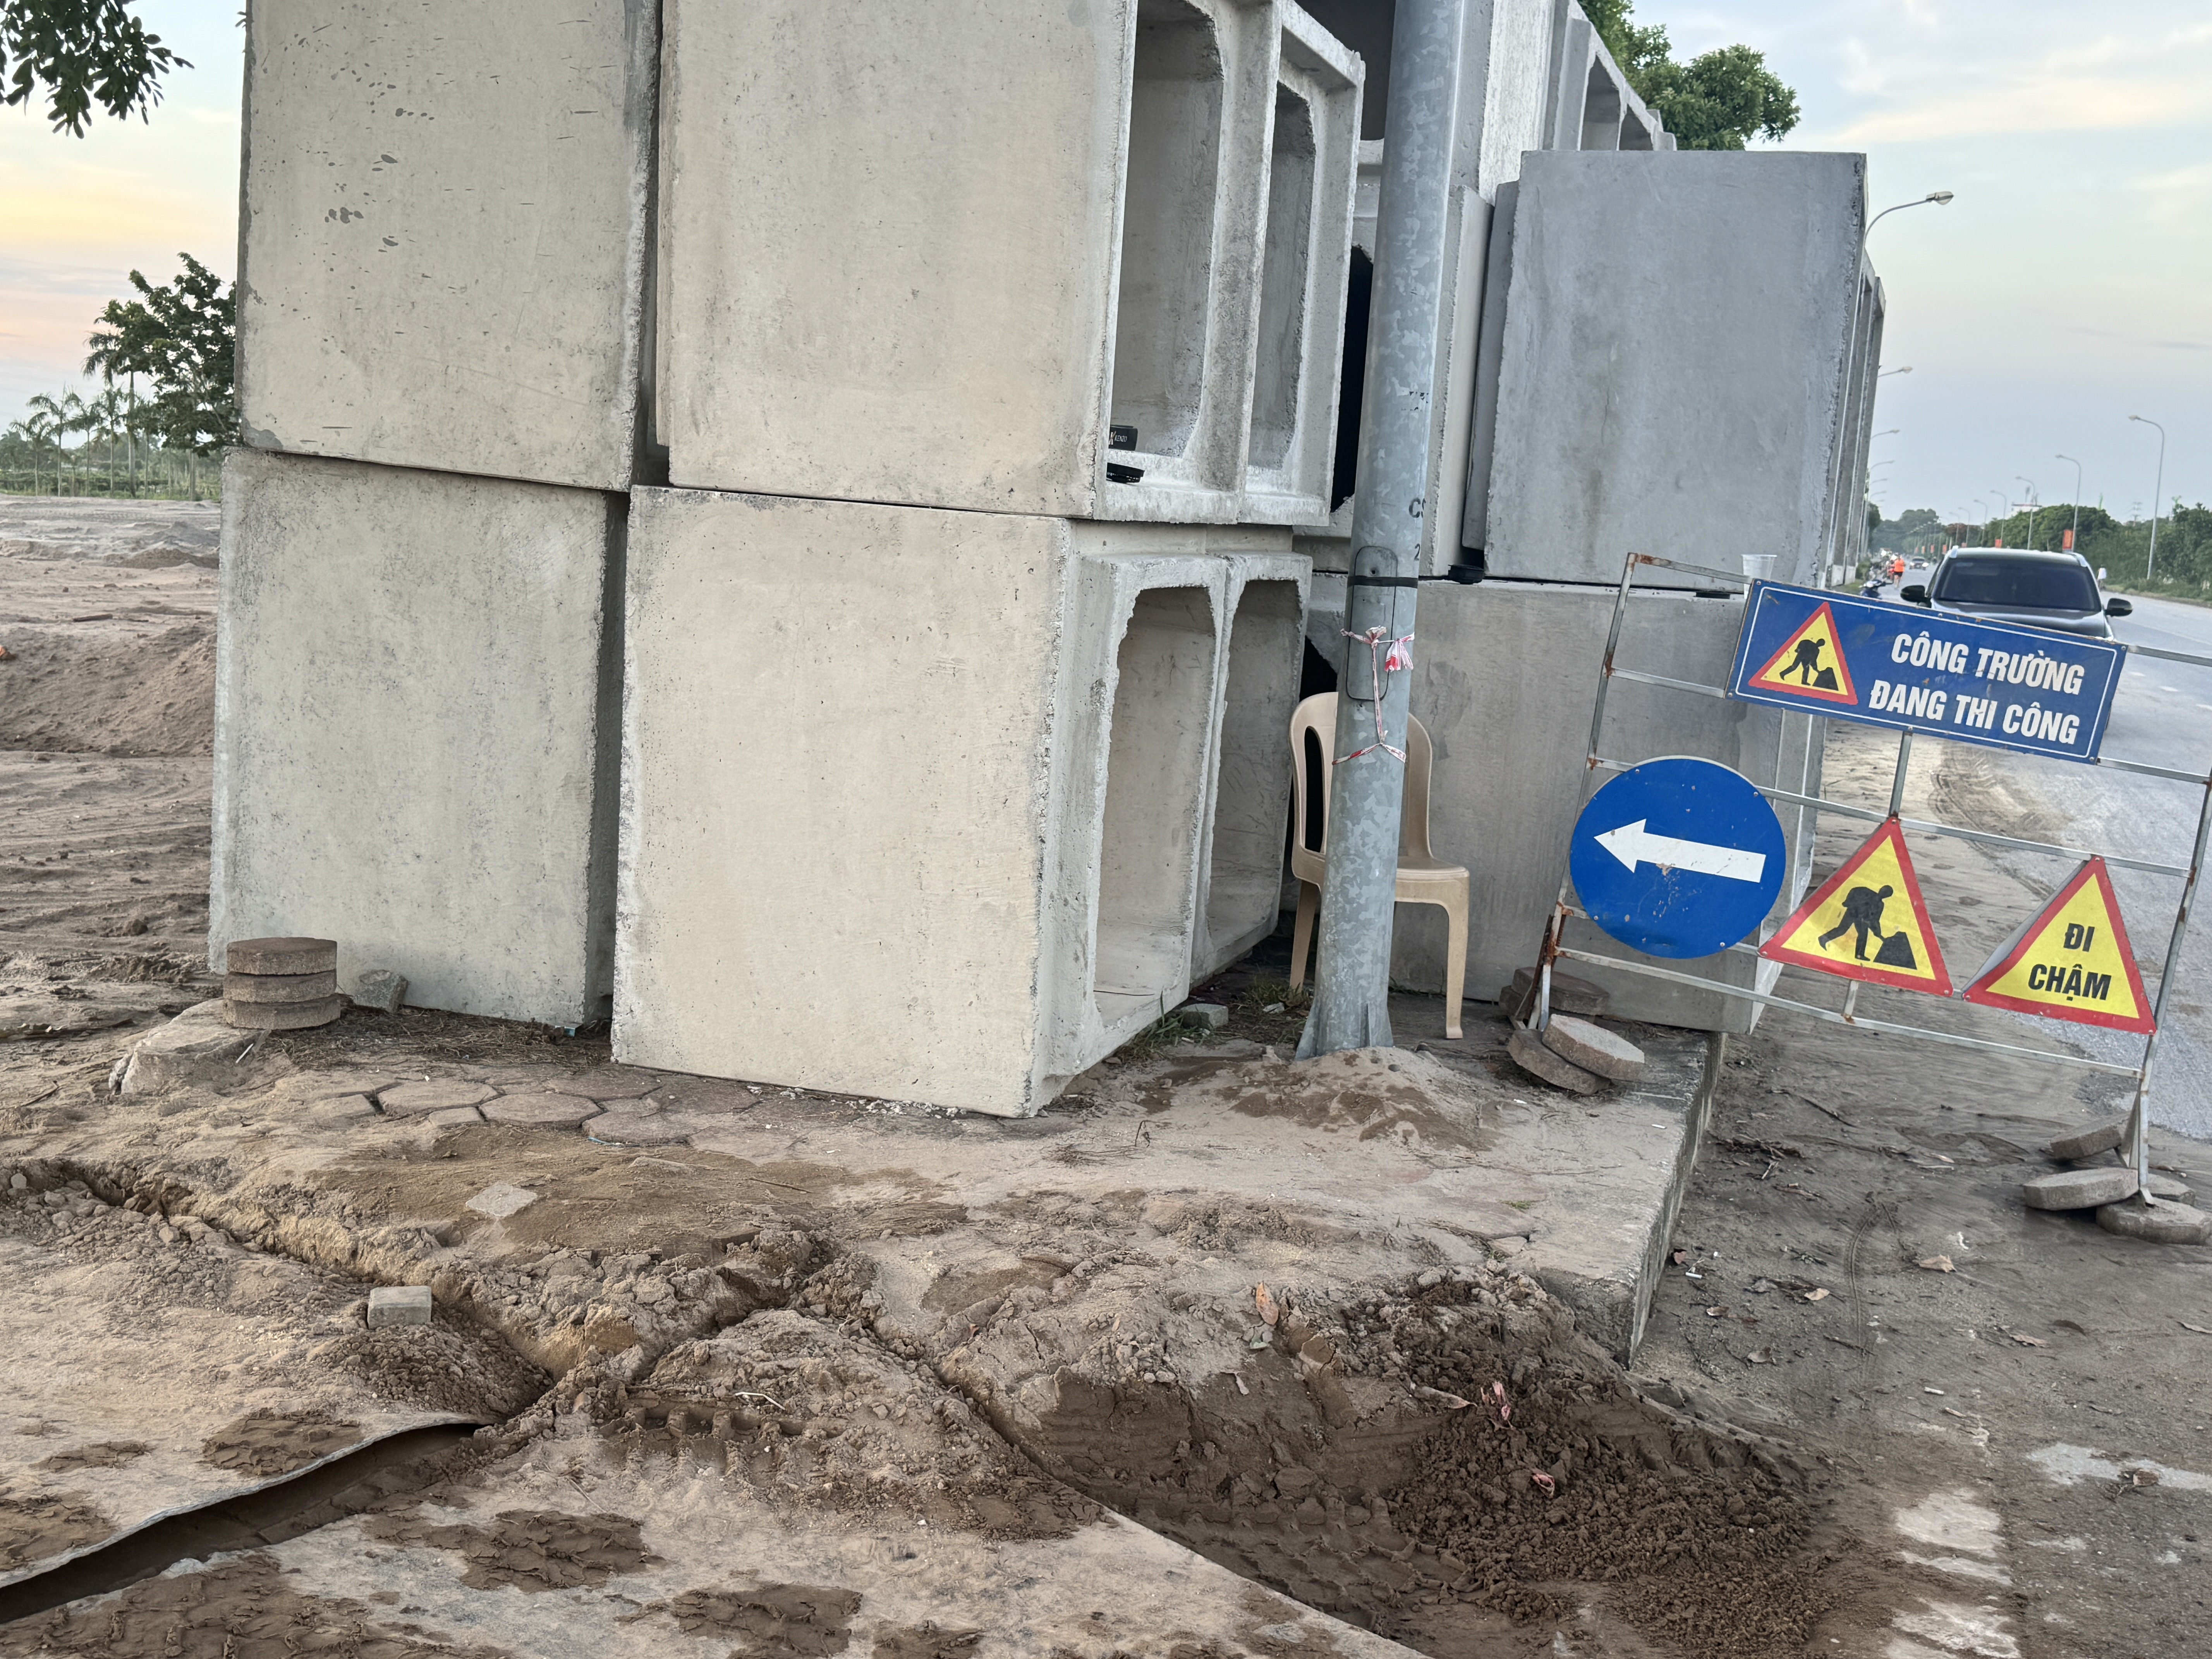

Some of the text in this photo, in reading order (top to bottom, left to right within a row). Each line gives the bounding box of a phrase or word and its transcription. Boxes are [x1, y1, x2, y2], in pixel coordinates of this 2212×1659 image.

[1891, 630, 2085, 695] CÔNG TRƯỜNG
[1868, 679, 2080, 745] ĐANG THI CÔNG
[2063, 923, 2095, 952] ĐI
[2028, 964, 2112, 1001] CHẬM
